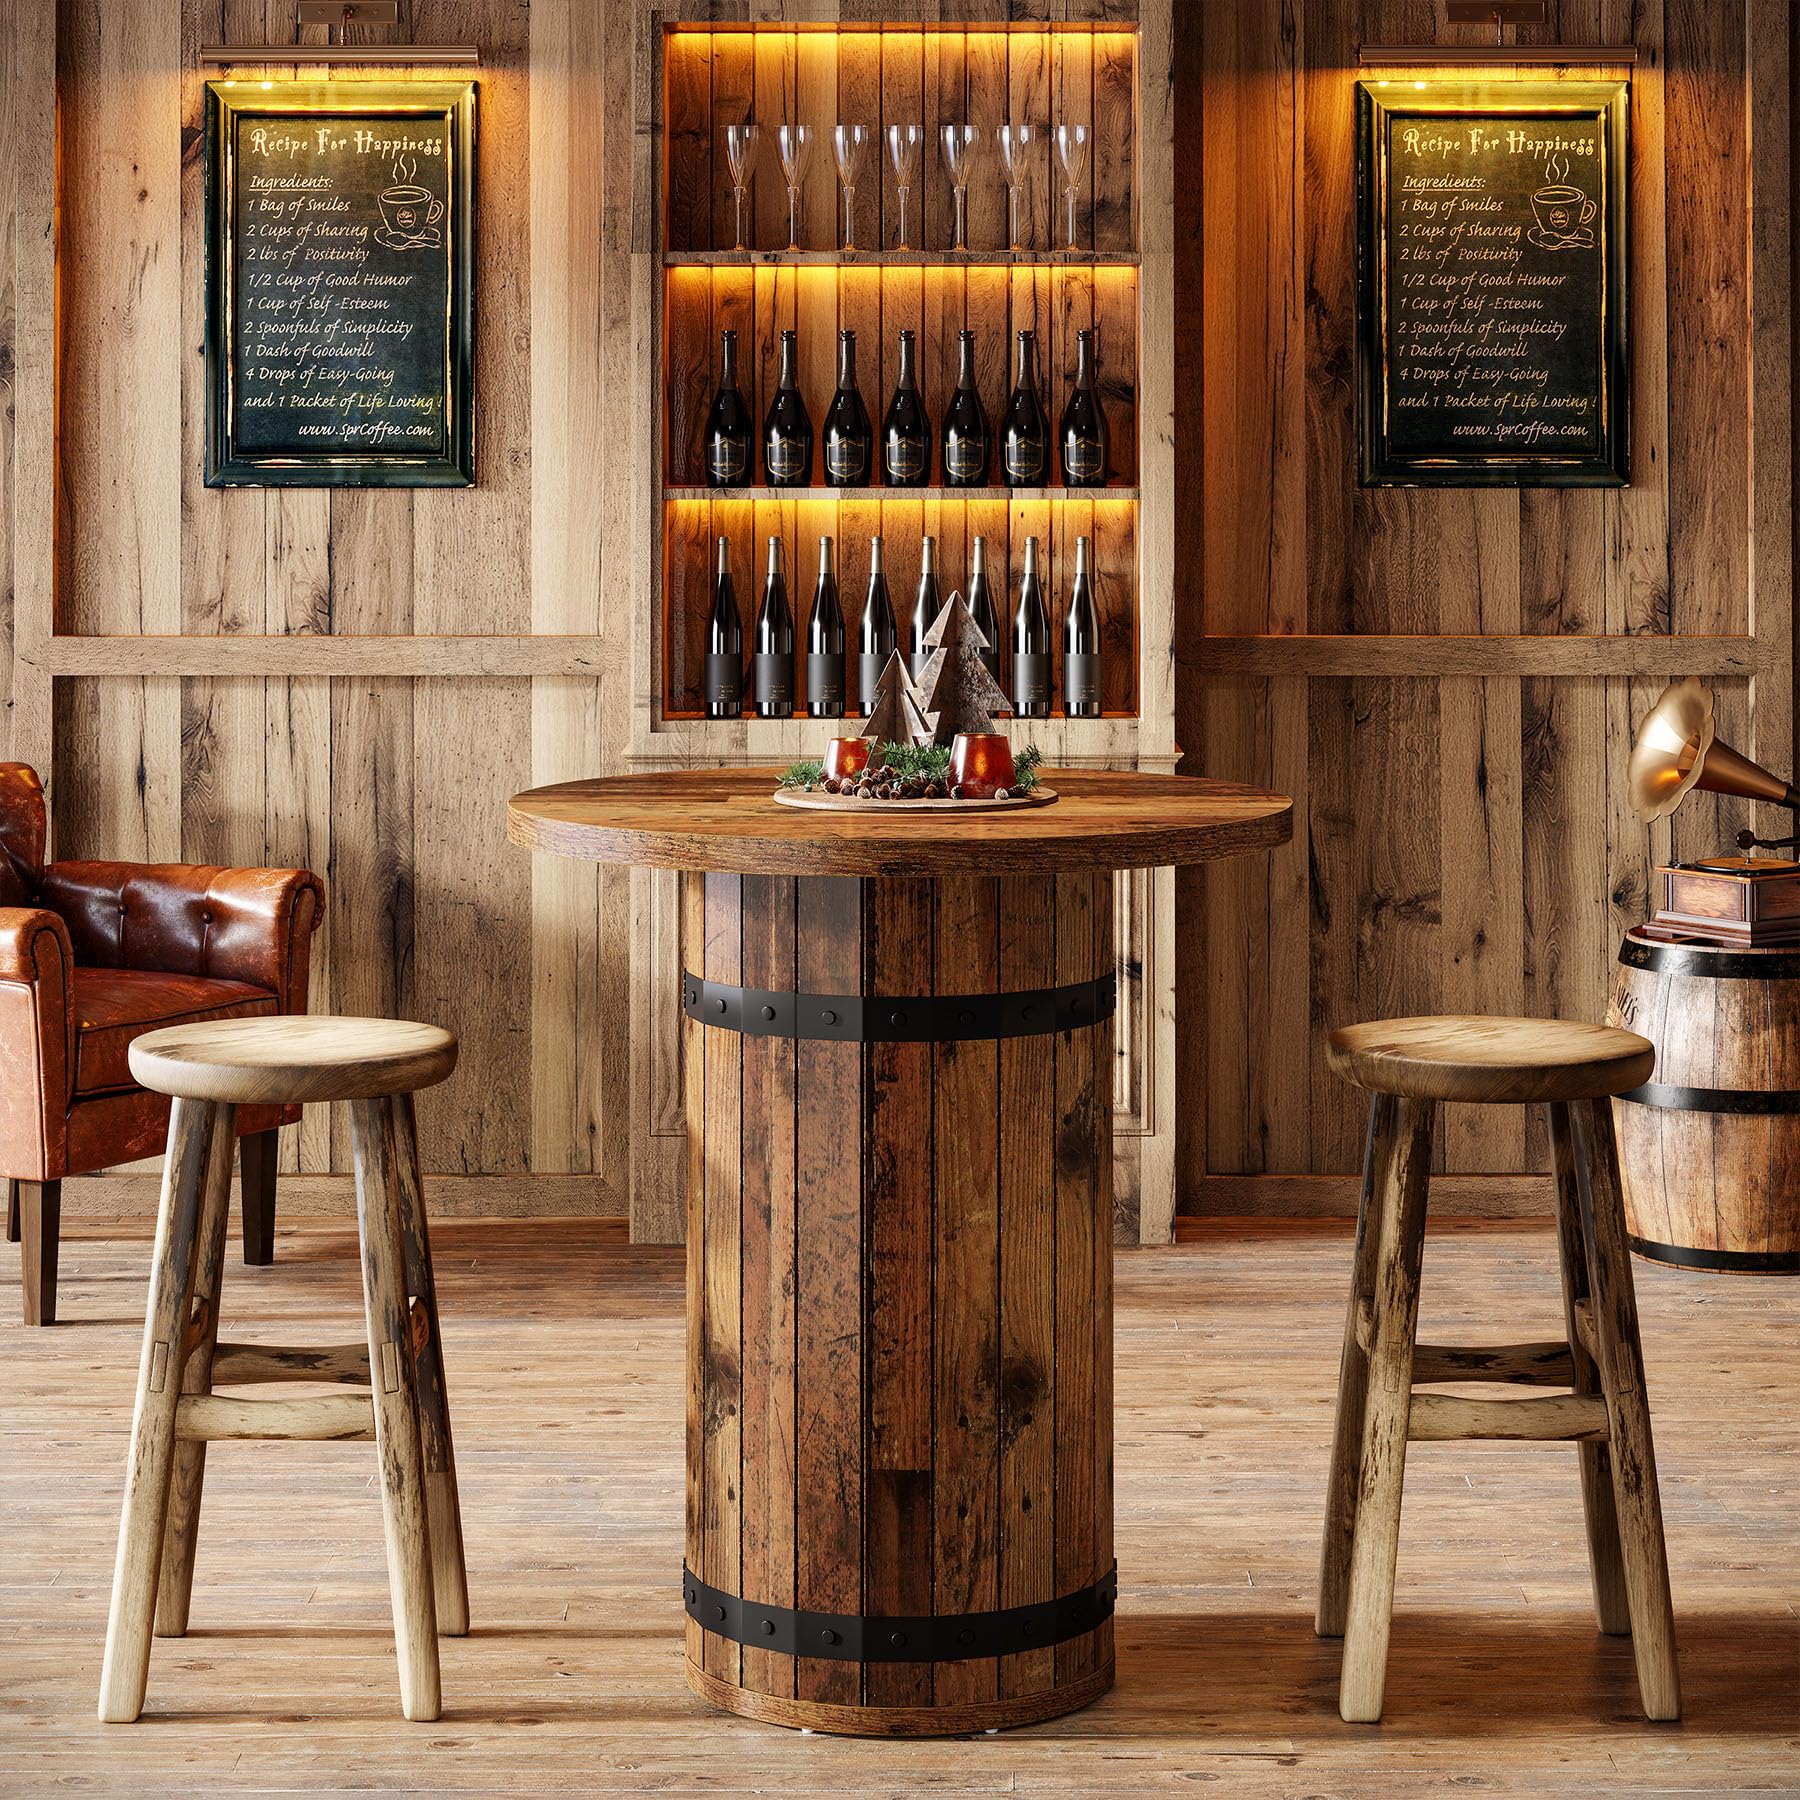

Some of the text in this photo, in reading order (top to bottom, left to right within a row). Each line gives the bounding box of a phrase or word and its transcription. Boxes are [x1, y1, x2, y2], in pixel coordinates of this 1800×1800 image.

[250, 128, 441, 159] Recipe For Happiness
[1403, 128, 1595, 159] Recipe For Happiness
[249, 173, 333, 195] Ingredients:
[1402, 173, 1486, 195] Ingredients:
[249, 196, 350, 220] 1 Bag of Smiles
[1401, 196, 1503, 220] 1 Bag of Smiles
[246, 222, 368, 245] 2 Cups of Sharing
[1400, 222, 1521, 245] 2 Cups of Sharing
[247, 246, 369, 269] 2 lbs of Positivity
[1400, 246, 1523, 269] 2 lbs of Positivity
[249, 271, 412, 294] 1/2 Cup of Good Humor
[1402, 271, 1566, 294] 1/2 Cup of Good Humor
[247, 298, 252, 309] 1
[258, 298, 287, 315] Cup
[290, 295, 305, 318] of
[1401, 298, 1406, 309] 1
[1412, 298, 1440, 315] Cup
[1443, 295, 1458, 318] of
[244, 319, 413, 342] 2 Spoonfuls of Simplicity
[1398, 319, 1567, 342] 2 Spoonfuls of Simplicity
[245, 342, 375, 365] 1 Dash of Goodwill
[1399, 342, 1529, 365] 1 Dash of Goodwill
[246, 366, 395, 388] 4 Drops of Easy-Going
[1400, 366, 1549, 388] 4 Drops of Easy-Going
[244, 393, 274, 407] and
[279, 396, 284, 406] 1
[290, 393, 336, 407] Packet
[340, 393, 355, 416] of
[358, 393, 386, 414] Life
[1399, 393, 1429, 407] and
[1434, 396, 1439, 406] 1
[1444, 393, 1490, 407] Packet
[1494, 393, 1510, 416] of
[1512, 393, 1540, 414] Life
[299, 421, 434, 444] www.SprCoffee.com
[1453, 421, 1588, 444] www.SprCoffee.com
